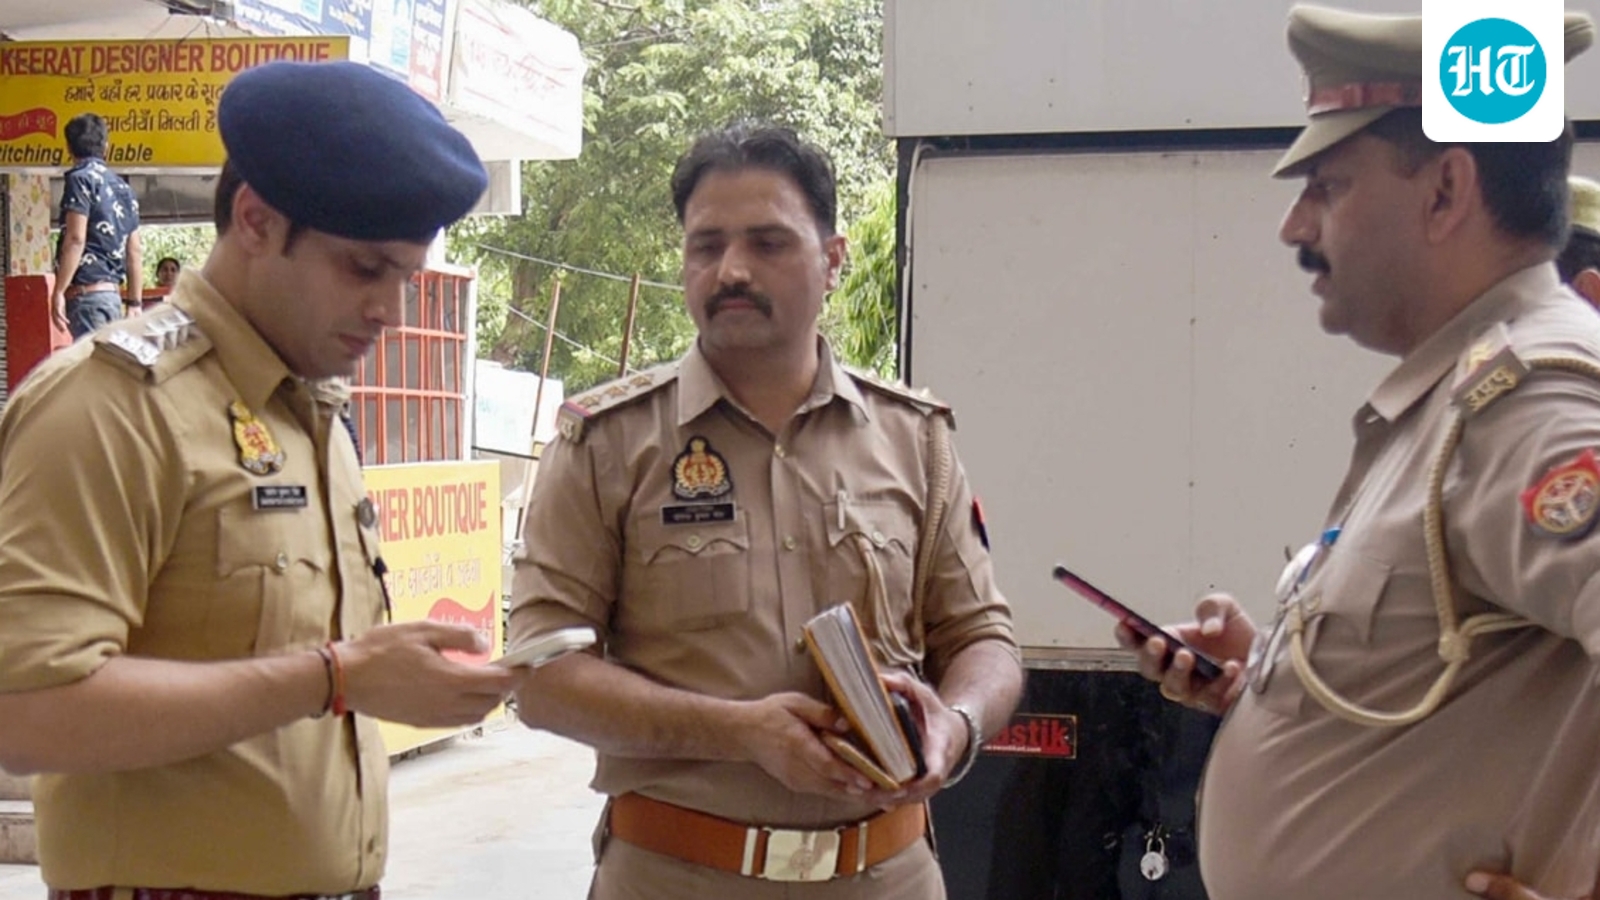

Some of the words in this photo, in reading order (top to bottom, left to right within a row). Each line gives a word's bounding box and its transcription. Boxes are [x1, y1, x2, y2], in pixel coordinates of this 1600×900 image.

[0, 46, 85, 75] KEERAT
[91, 43, 204, 74] DESIGNER
[211, 42, 330, 72] BOUTIQUE
[64, 78, 95, 103] हमारे
[124, 84, 141, 102] हर
[146, 83, 183, 102] प्रकार
[185, 77, 198, 100] के
[158, 109, 199, 131] मिलती
[0, 144, 63, 166] itching
[413, 481, 487, 538] BOUTIQUE
